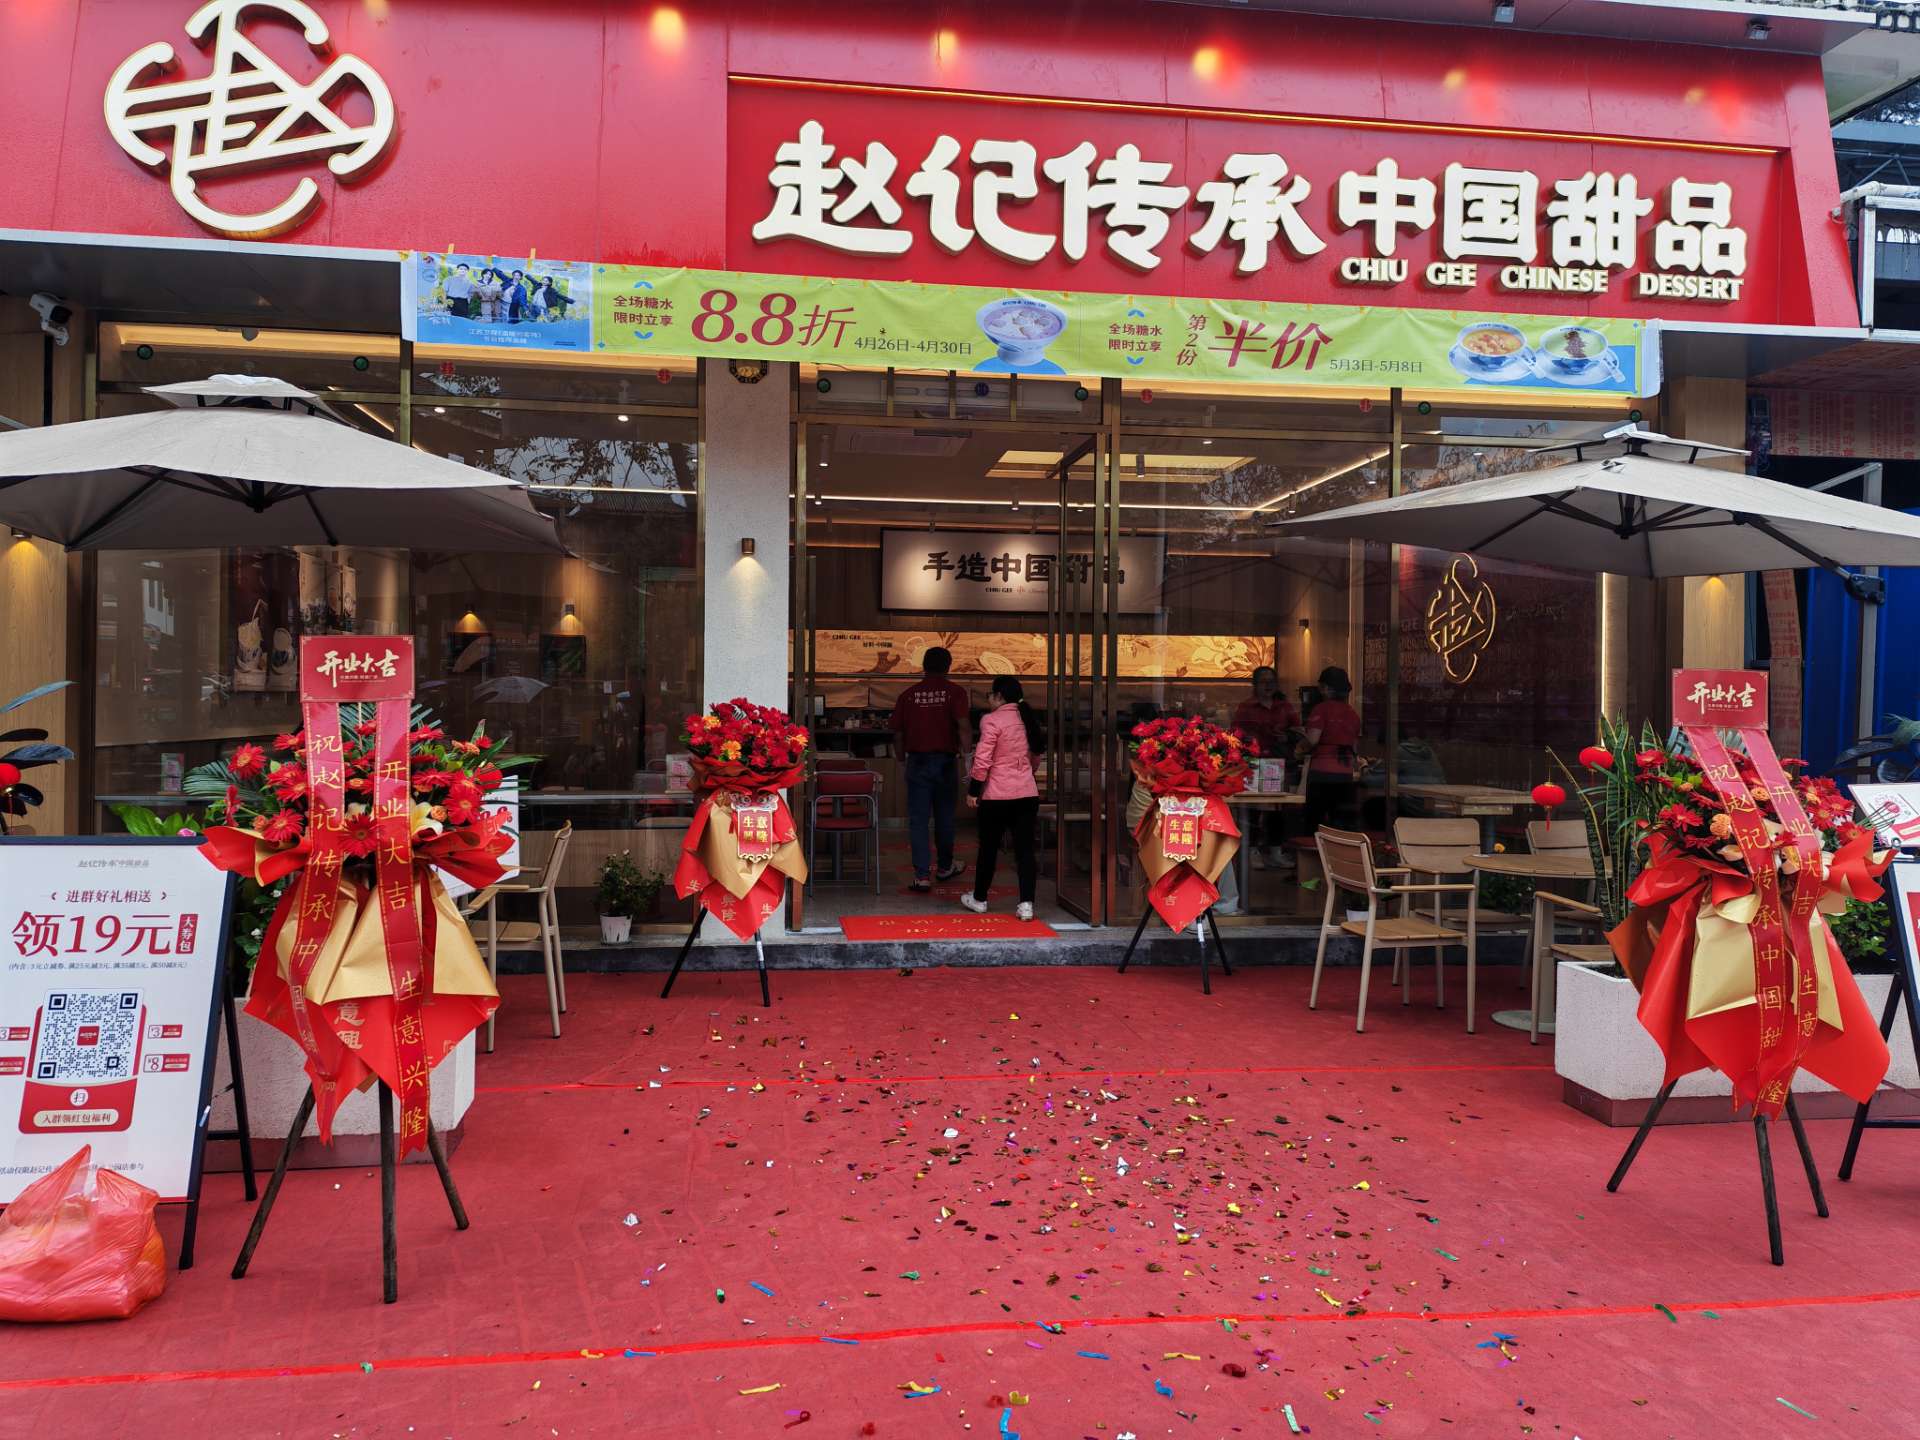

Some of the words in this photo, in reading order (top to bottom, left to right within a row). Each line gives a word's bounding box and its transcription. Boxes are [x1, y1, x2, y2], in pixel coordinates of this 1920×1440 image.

[752, 120, 1747, 277] 赵记传承中国甜品
[1341, 257, 1408, 283] CHIU
[1425, 262, 1478, 287] GEE
[1500, 266, 1608, 292] CHINESE
[1640, 273, 1744, 300] DESSERT
[613, 294, 674, 310] 全场糖水
[613, 312, 674, 326] 限时立享
[691, 289, 857, 349] 8.8折
[1108, 323, 1163, 337] 全场糖水
[854, 336, 973, 355] 4月26日-4月30日
[1108, 339, 1162, 353] 限时立享
[1176, 314, 1208, 367] 第2份
[1207, 320, 1333, 370] 半价
[1330, 359, 1424, 373] 5月3日-5月8日
[316, 649, 400, 688] 开业大吉
[1687, 682, 1757, 715] 开业大吉
[66, 890, 152, 903] 进群好礼相送
[12, 911, 174, 957] 领19元
[380, 760, 409, 910] 开业大吉
[399, 971, 425, 1138] 生意兴隆
[73, 1092, 86, 1103] 扫
[42, 1113, 112, 1124] 入群领红包福利
